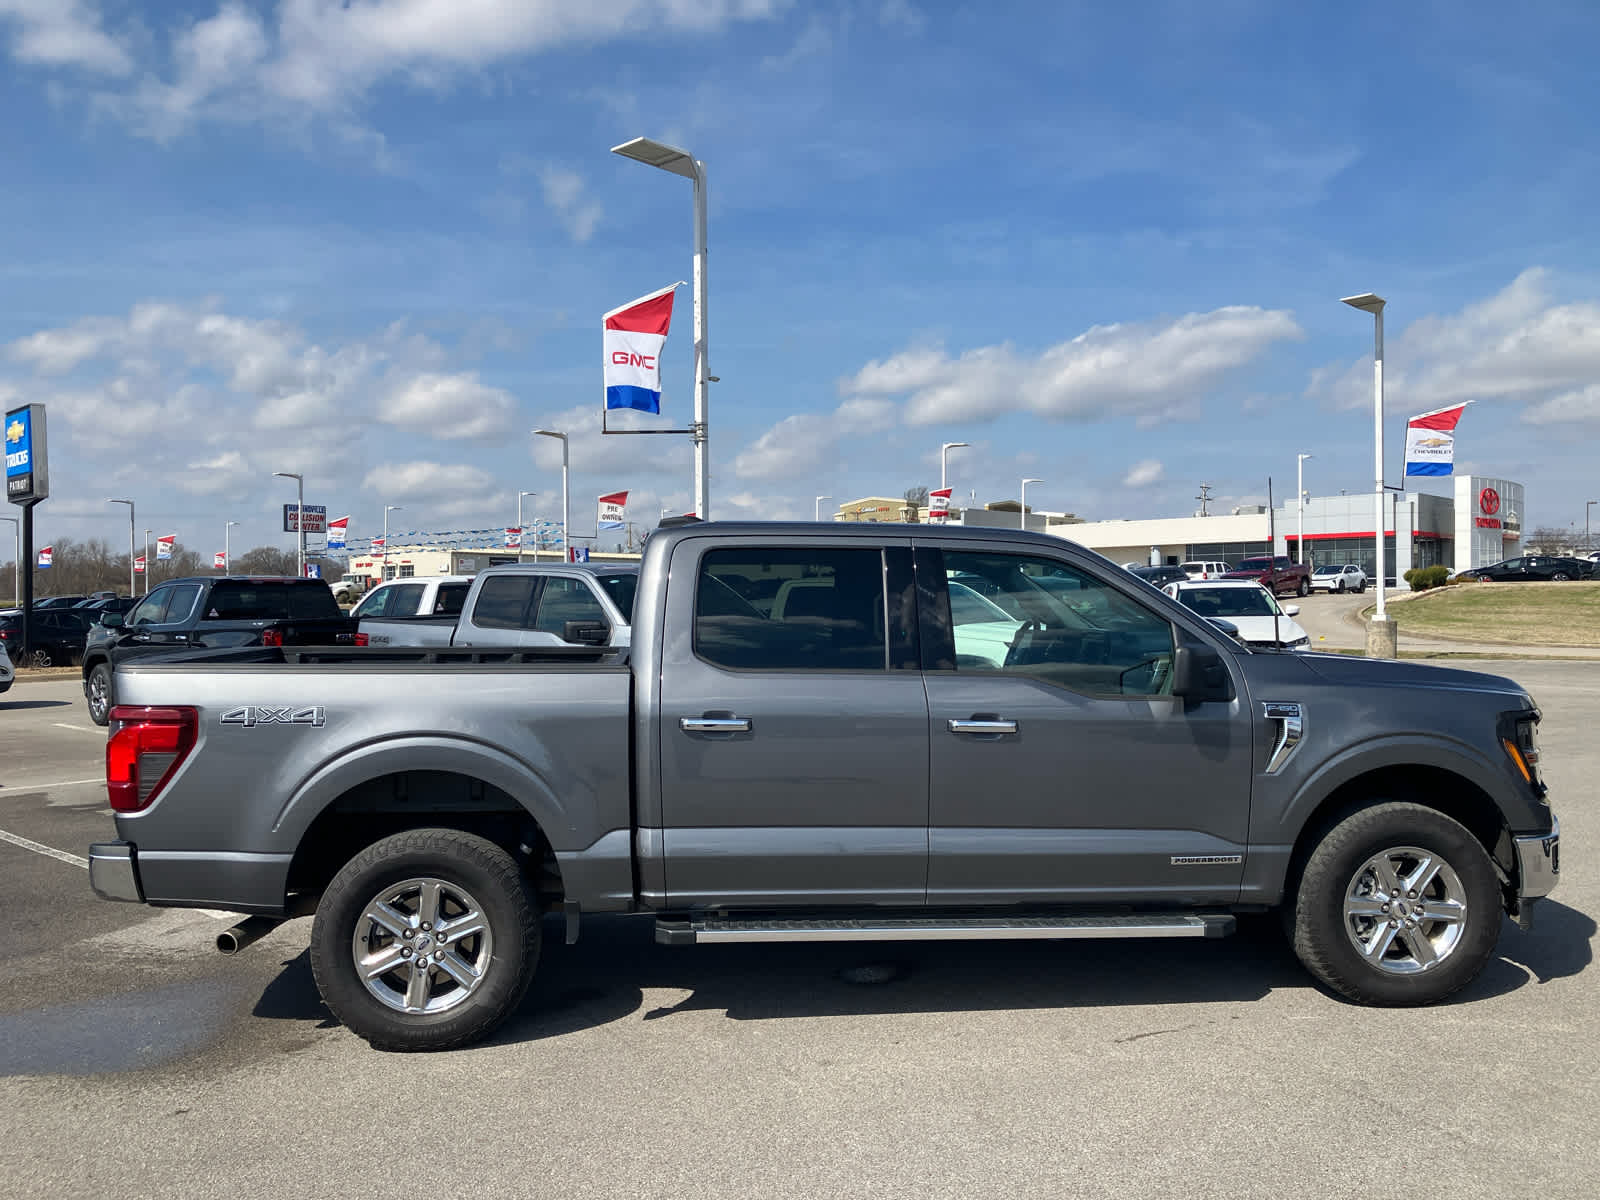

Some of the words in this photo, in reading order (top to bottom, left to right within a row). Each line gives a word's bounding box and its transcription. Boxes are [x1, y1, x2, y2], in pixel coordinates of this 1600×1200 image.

[612, 351, 656, 370] GMC
[6, 449, 29, 468] TRUCKS
[289, 512, 324, 522] COLISION
[1475, 517, 1502, 529] TOYOTA
[293, 522, 320, 531] CNTER
